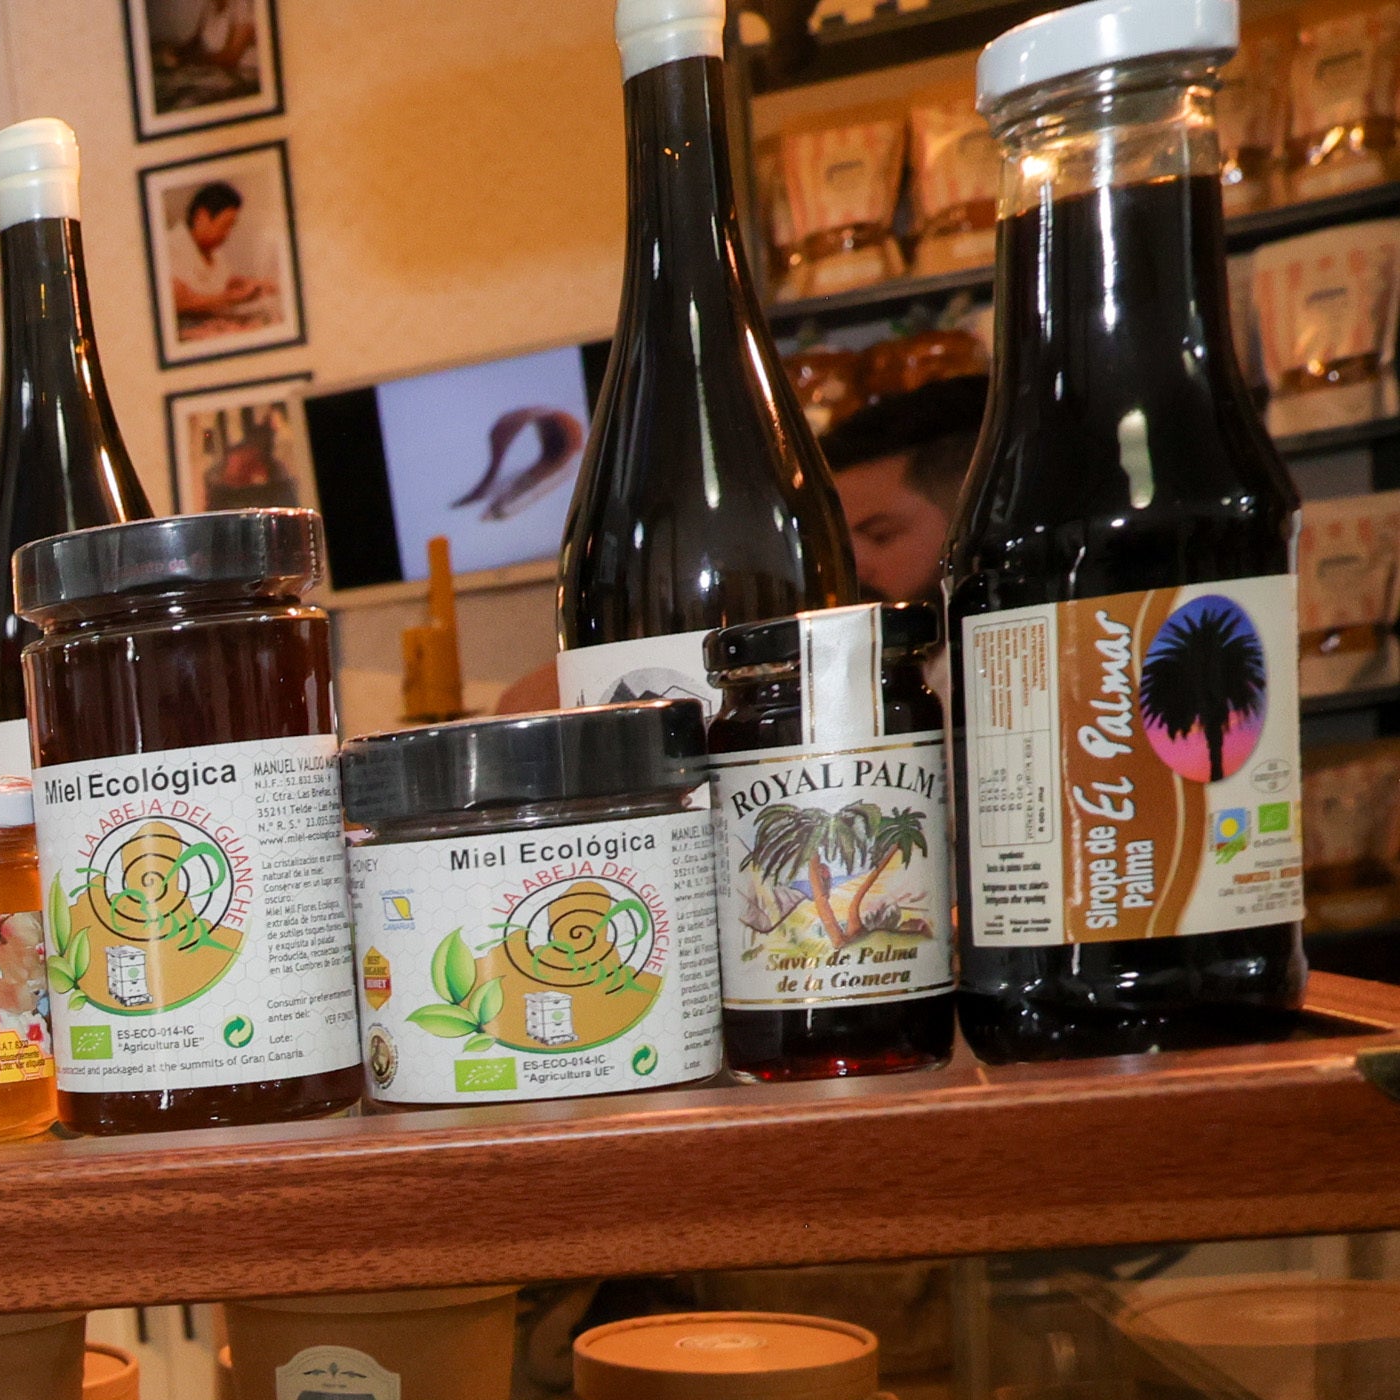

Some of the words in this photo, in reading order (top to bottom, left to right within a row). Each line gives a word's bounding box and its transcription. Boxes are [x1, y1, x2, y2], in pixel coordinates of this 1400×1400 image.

[254, 759, 296, 776] MANUEL
[44, 776, 82, 805] Miel
[89, 763, 236, 799] Ecológica
[731, 762, 843, 820] ROYAL
[853, 760, 935, 799] PALM
[290, 804, 312, 814] Telde
[1086, 826, 1118, 853] de
[450, 846, 506, 871] Miel
[520, 833, 656, 864] Ecológica
[78, 834, 100, 858] LA
[98, 799, 164, 834] ABEJA
[171, 800, 212, 830] DEL
[215, 825, 253, 927] GUANCHE
[262, 871, 291, 882] natural
[1123, 840, 1154, 908] Palma
[264, 882, 301, 893] Conservar
[1085, 859, 1118, 929] Sirope
[266, 907, 283, 916] Miel
[492, 892, 522, 915] LA
[522, 861, 593, 893] ABEJA
[601, 862, 638, 888] DEL
[639, 883, 670, 972] GUANCHE
[276, 939, 308, 951] exquisita
[766, 951, 820, 971] Savia
[827, 948, 850, 965] de
[857, 945, 918, 964] Palma
[777, 976, 797, 993] de
[804, 975, 823, 991] la
[831, 969, 911, 988] Gomera
[267, 997, 307, 1009] Consumir
[268, 1012, 292, 1022] antes
[117, 1026, 194, 1039] ES-ECO-014-IC
[269, 1035, 293, 1044] Lote:
[102, 1065, 143, 1076] packaged
[180, 1060, 224, 1070] summits
[241, 1054, 265, 1064] Gran
[523, 1055, 606, 1071] ES-ECO-014-IC
